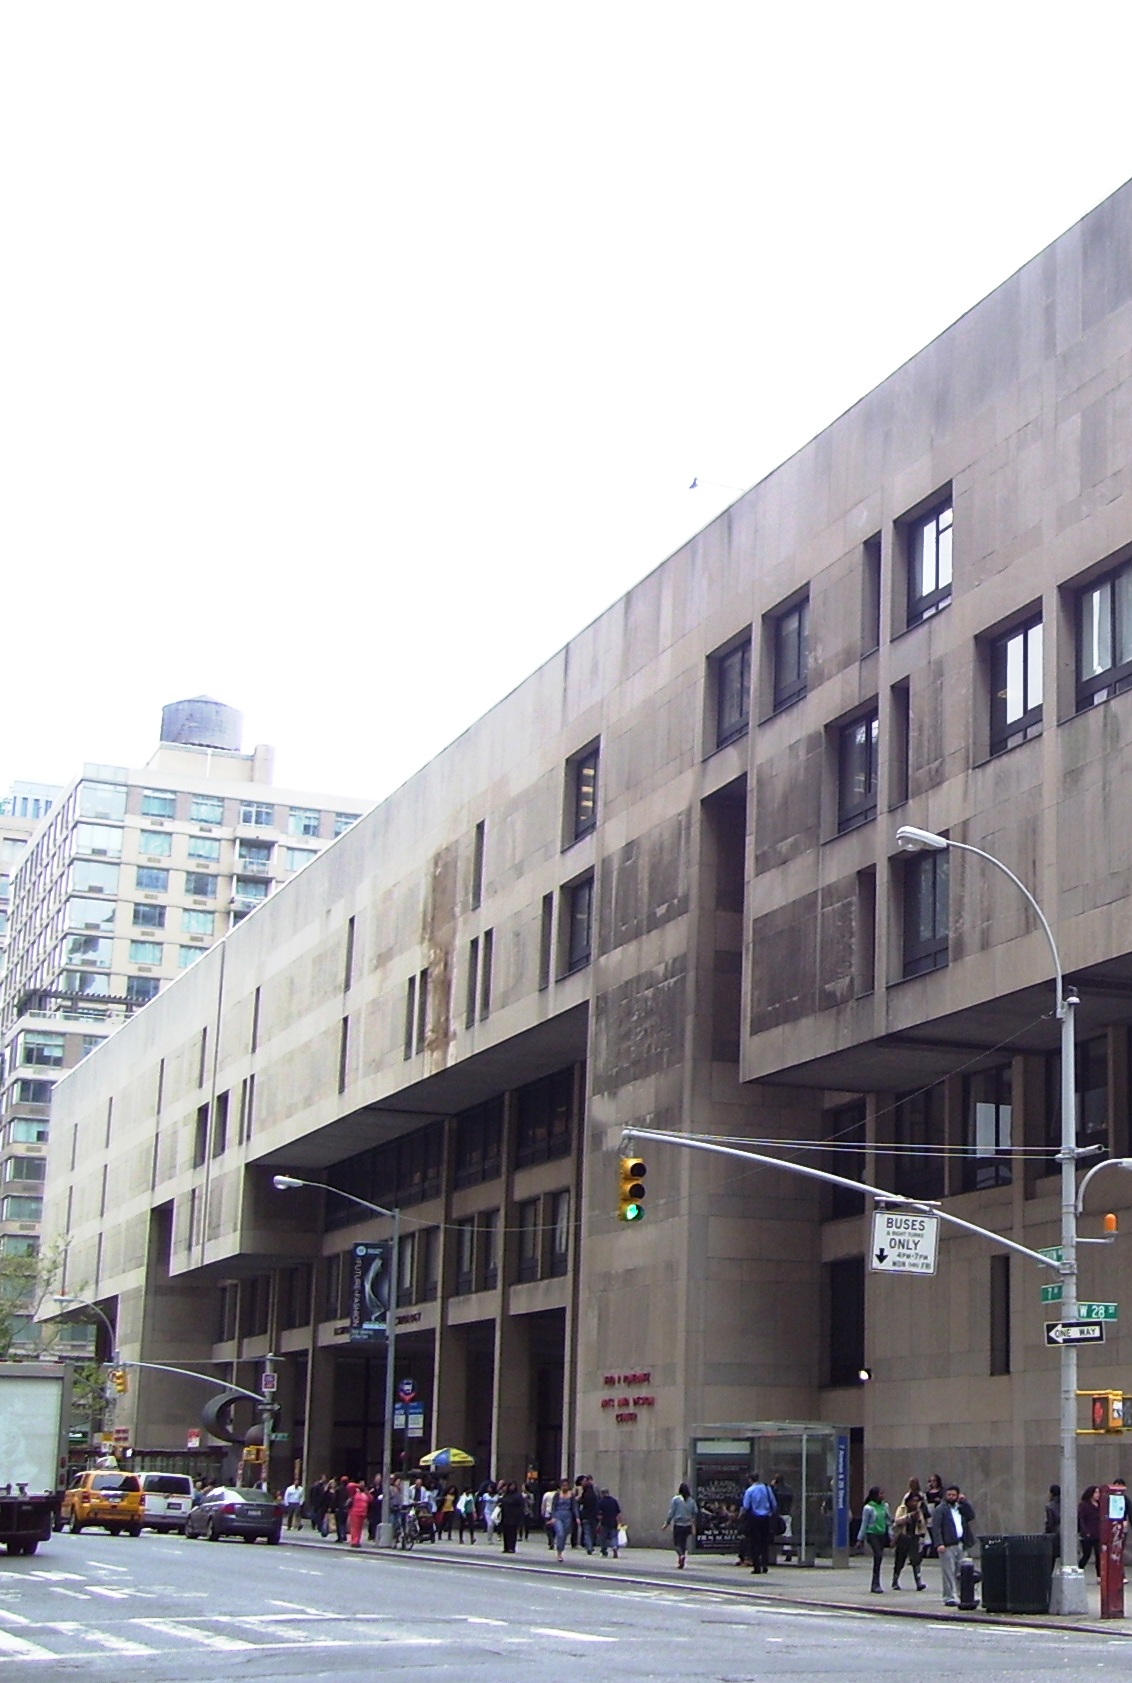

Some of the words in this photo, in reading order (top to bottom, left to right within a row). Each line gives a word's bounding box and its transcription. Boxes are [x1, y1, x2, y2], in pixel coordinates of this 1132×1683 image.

[886, 1217, 926, 1231] BUSES
[889, 1238, 921, 1251] ONLY
[1047, 1288, 1052, 1300] 7
[1079, 1305, 1088, 1317] W
[1091, 1305, 1105, 1318] 28
[1054, 1328, 1072, 1338] ONE
[1079, 1327, 1096, 1336] WAY
